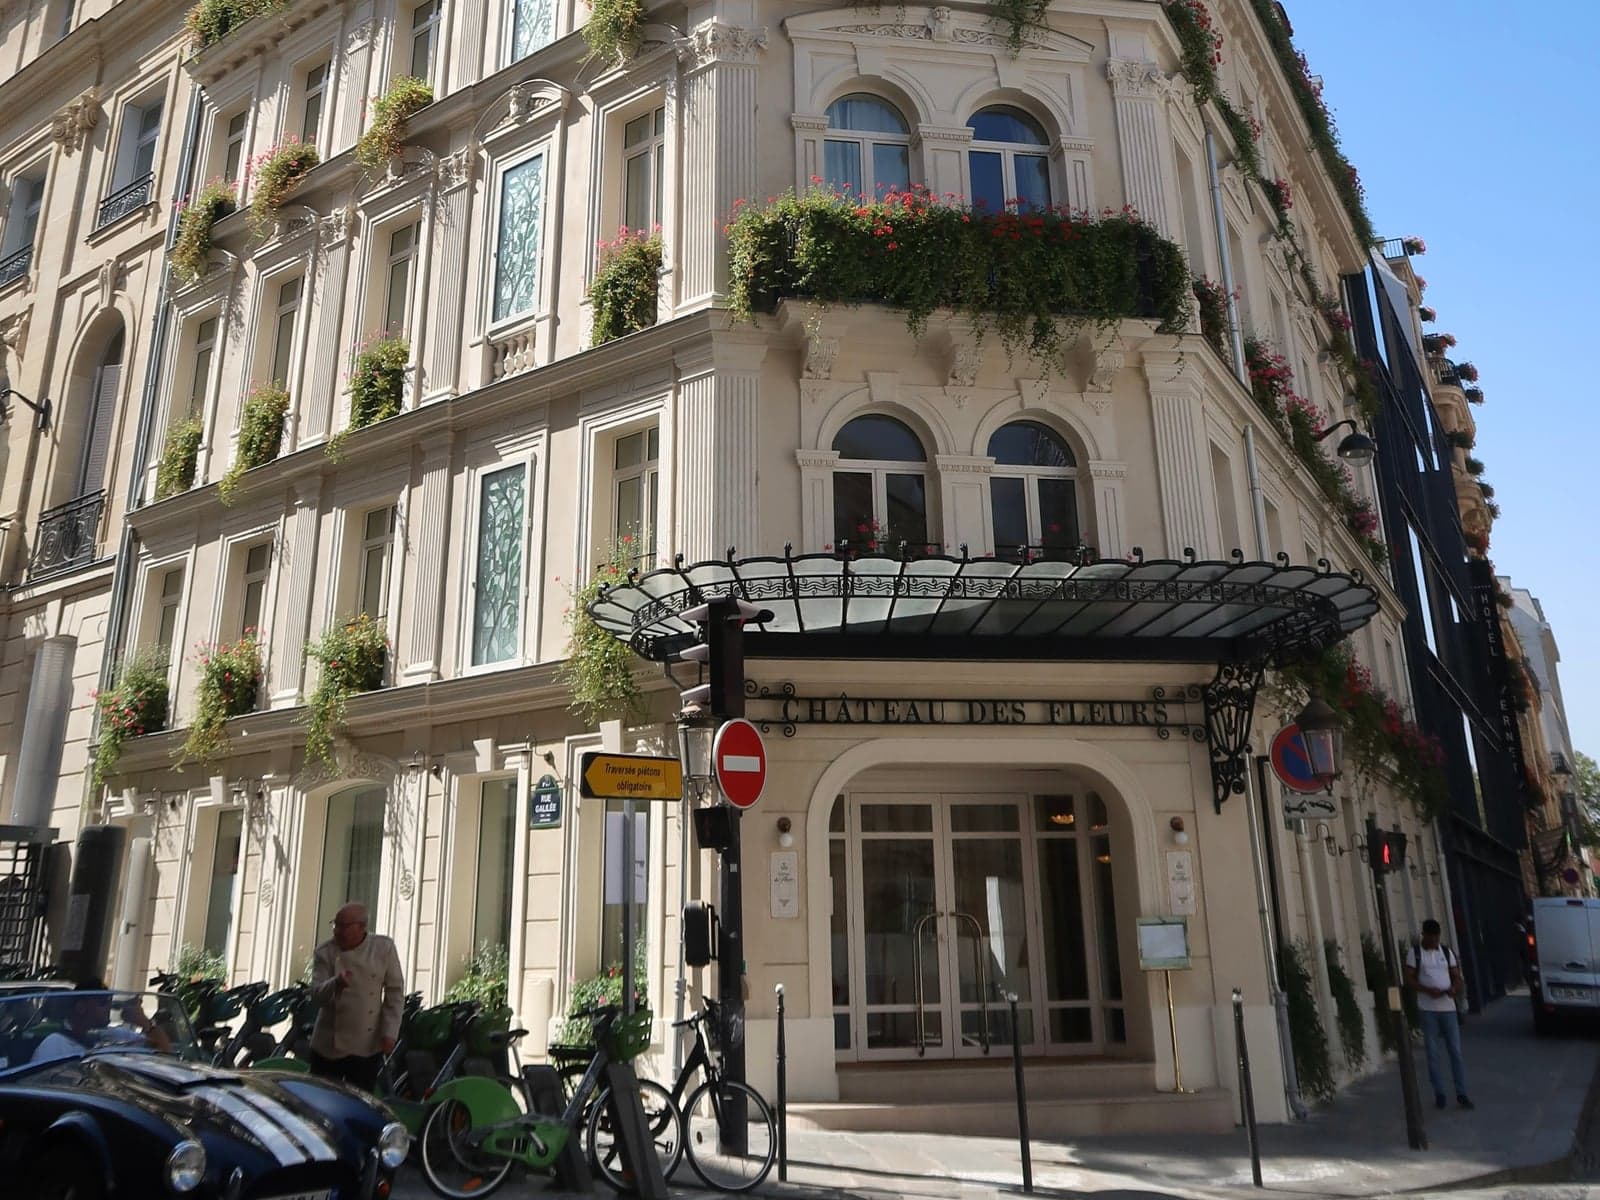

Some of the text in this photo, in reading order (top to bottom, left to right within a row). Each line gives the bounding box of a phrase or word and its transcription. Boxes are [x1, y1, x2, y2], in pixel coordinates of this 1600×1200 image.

[1480, 592, 1499, 657] HOTEL
[783, 692, 1168, 725] CHÂTEAU DES FLEURS
[637, 764, 661, 778] piétons
[617, 781, 652, 793] obligatoire
[541, 794, 551, 802] RUE
